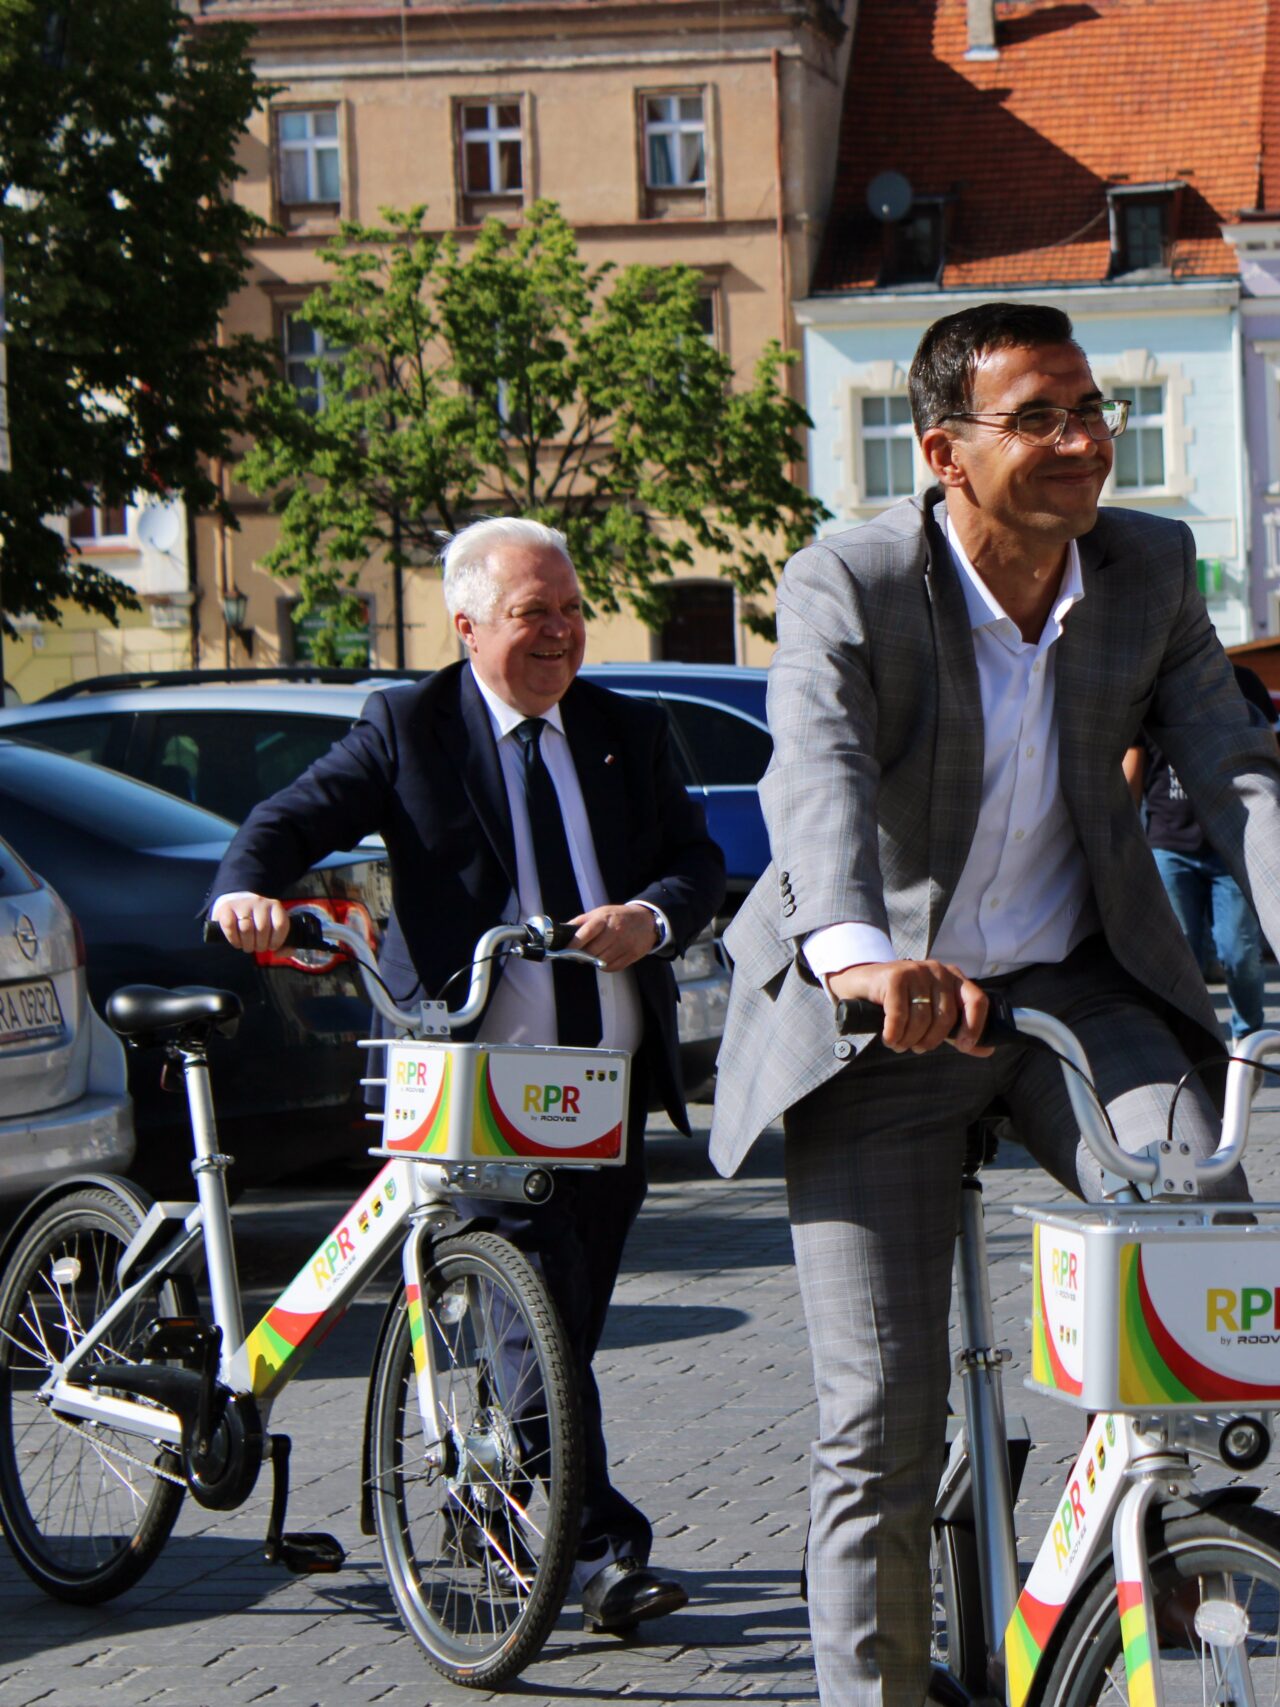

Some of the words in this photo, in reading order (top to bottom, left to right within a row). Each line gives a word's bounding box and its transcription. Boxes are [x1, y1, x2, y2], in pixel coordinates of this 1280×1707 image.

[397, 1061, 427, 1086] RPR
[523, 1084, 581, 1114] RPR
[312, 1226, 355, 1290] RPR
[1052, 1247, 1078, 1291] RPR
[1220, 1336, 1232, 1346] by
[1053, 1480, 1085, 1569] RPR
